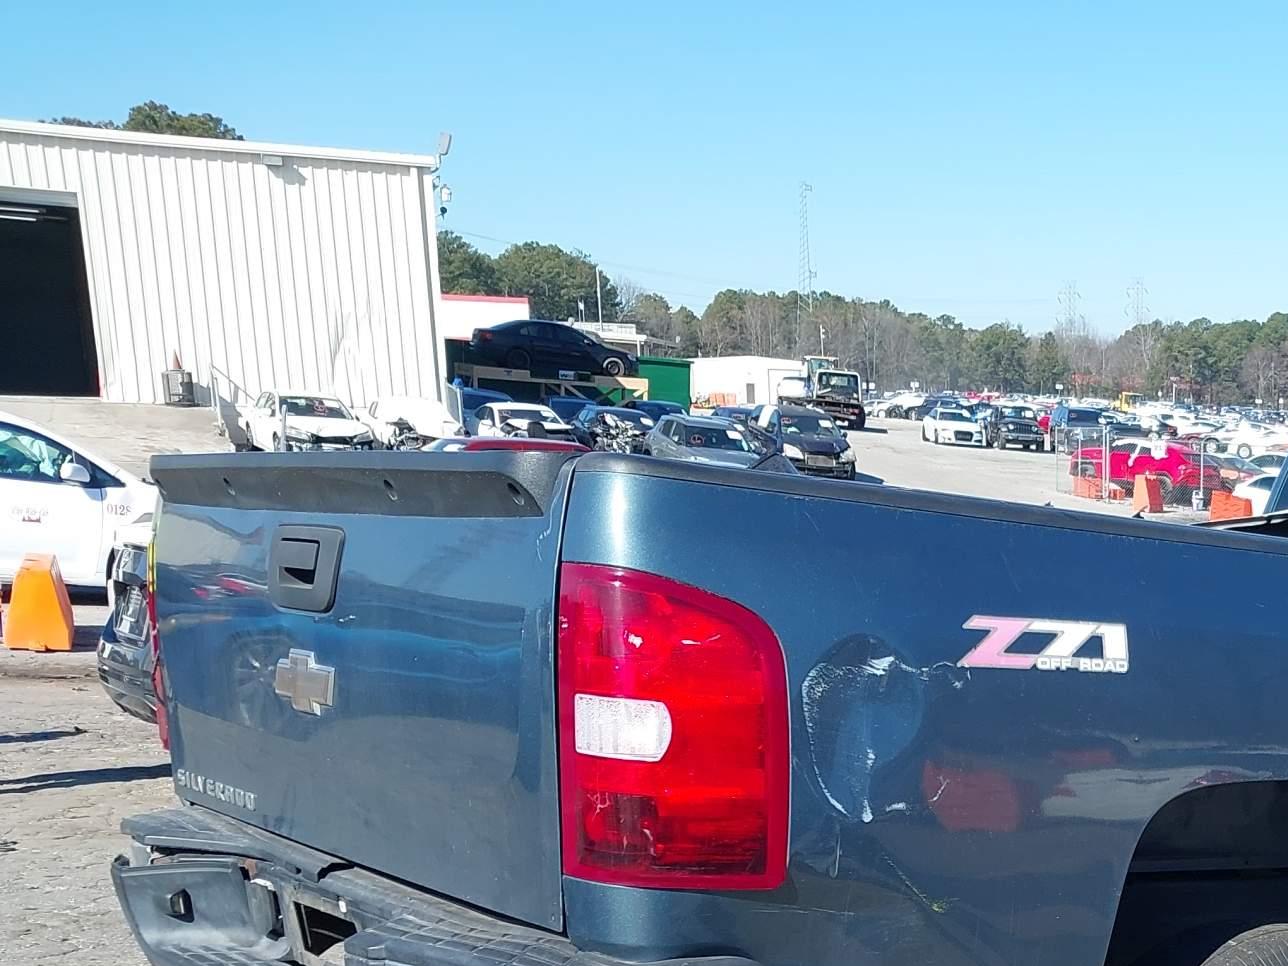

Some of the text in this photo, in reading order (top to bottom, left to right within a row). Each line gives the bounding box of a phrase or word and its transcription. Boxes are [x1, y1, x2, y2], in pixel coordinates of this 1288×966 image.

[957, 615, 1128, 670] Z71
[1036, 658, 1129, 673] OFF ROAD
[177, 768, 256, 811] SILVERADO
